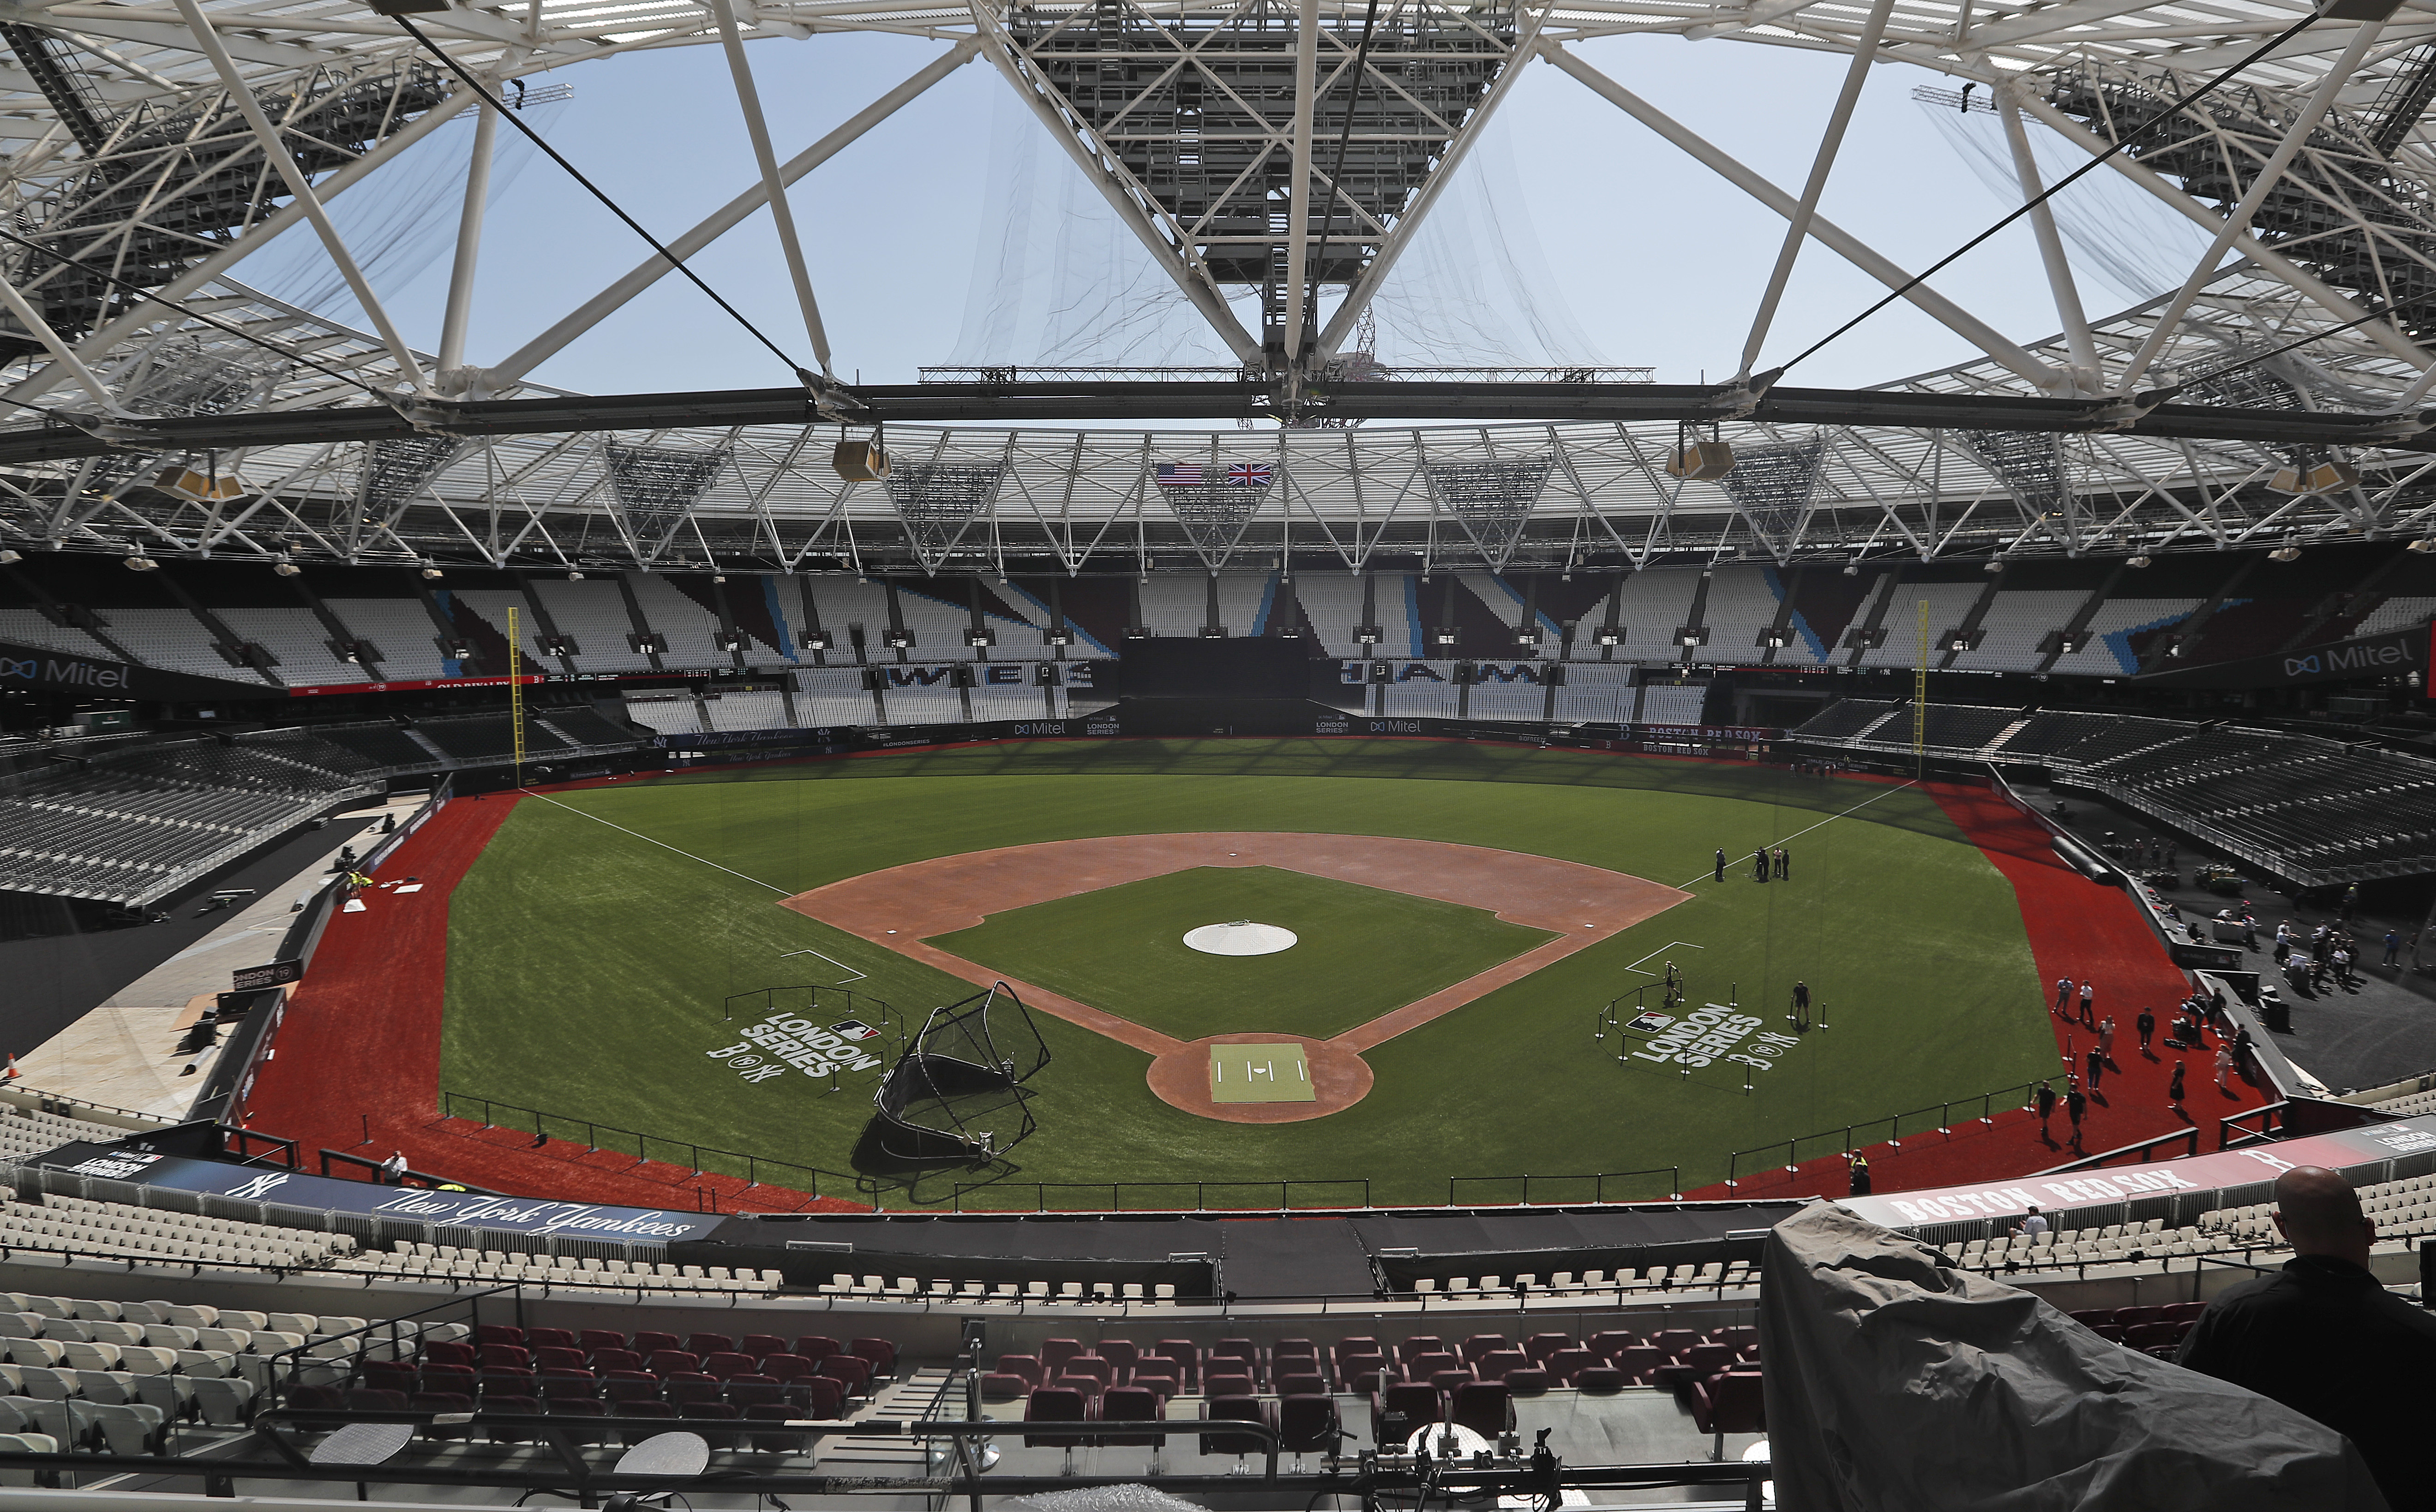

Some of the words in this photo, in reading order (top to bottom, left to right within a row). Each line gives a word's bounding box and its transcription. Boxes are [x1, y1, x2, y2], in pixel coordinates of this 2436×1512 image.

[2327, 639, 2413, 671] Mitel
[45, 660, 128, 689] Mitel
[1032, 721, 1065, 735] Mitel
[1388, 720, 1421, 732] Mitel
[1735, 730, 1761, 741] SOX
[694, 734, 720, 745] New
[1643, 744, 1673, 753] BOSTON
[1677, 746, 1691, 754] RED
[764, 1012, 882, 1072] LONDON
[1632, 1003, 1735, 1063] LONDON
[1674, 1015, 1763, 1068] SERIES
[740, 1024, 841, 1077] SERIES
[2374, 1131, 2436, 1146] LONDON
[67, 1165, 119, 1178] SERIES
[84, 1158, 149, 1173] LONDON
[1890, 1186, 2047, 1222] BOSTON
[2042, 1177, 2126, 1203] RED
[2111, 1169, 2198, 1192] SOX
[377, 1188, 461, 1214] New
[433, 1195, 559, 1227] York
[525, 1203, 695, 1237] Yankees
